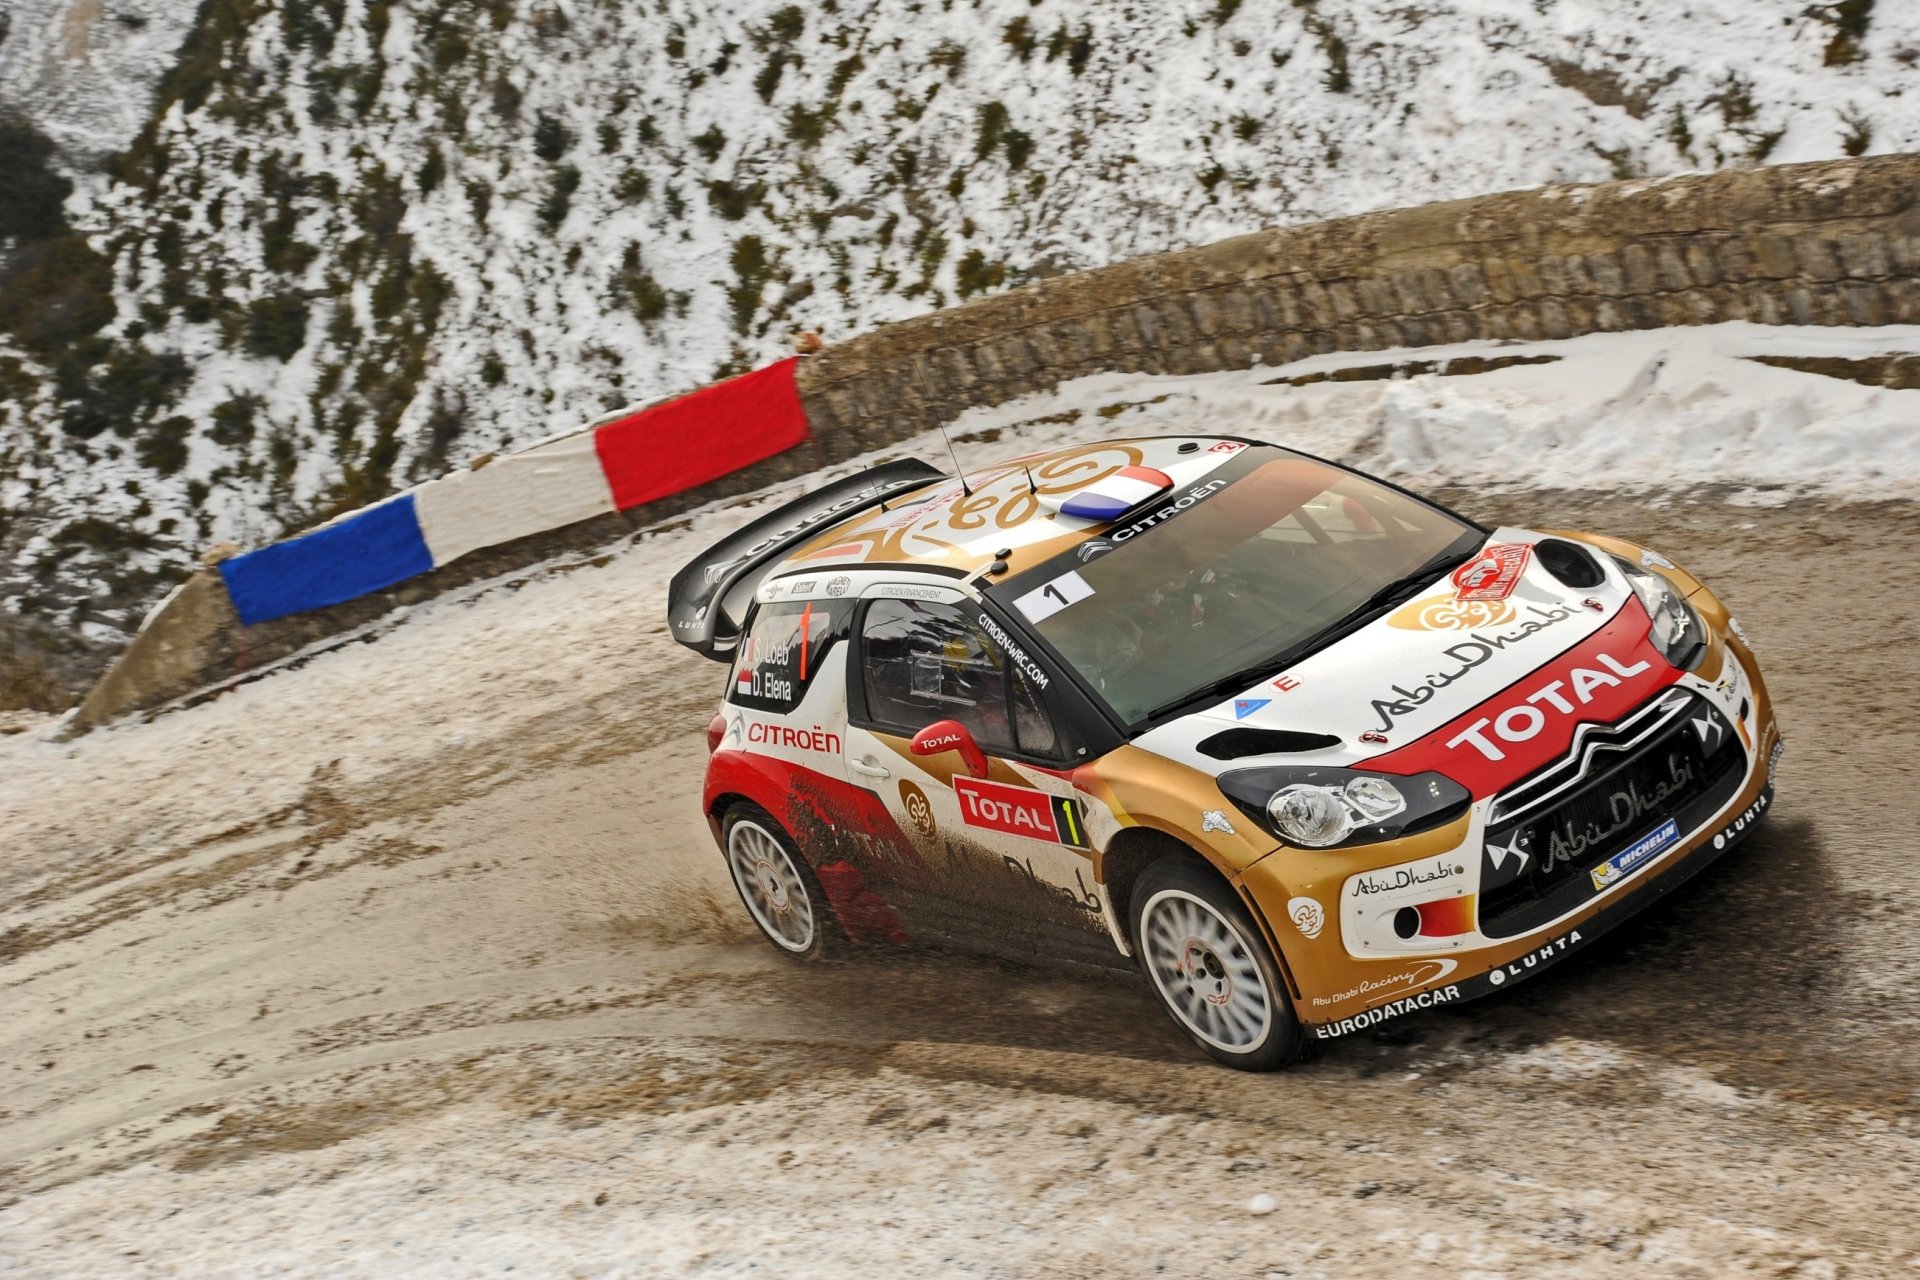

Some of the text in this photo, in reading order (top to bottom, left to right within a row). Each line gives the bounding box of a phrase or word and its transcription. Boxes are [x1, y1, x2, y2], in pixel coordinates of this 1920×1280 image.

[1043, 584, 1070, 606] 1
[765, 640, 789, 666] Loeb
[799, 601, 813, 680] 1
[978, 613, 1049, 690] CITROEN-WRC.COM
[752, 670, 792, 701] D. Elena
[1272, 675, 1300, 692] E
[1446, 653, 1652, 762] TOTAL
[748, 722, 841, 754] CITROËN
[921, 733, 961, 749] TOTAL
[960, 788, 1051, 832] TOTAL
[1062, 800, 1080, 845] 1
[1725, 795, 1767, 839] LUHTA
[1618, 825, 1675, 868] MICHELIN
[1509, 931, 1583, 976] LUHTA
[1313, 967, 1425, 1006] Abu Dhabi Racing
[1316, 985, 1461, 1039] EURODATACAR
